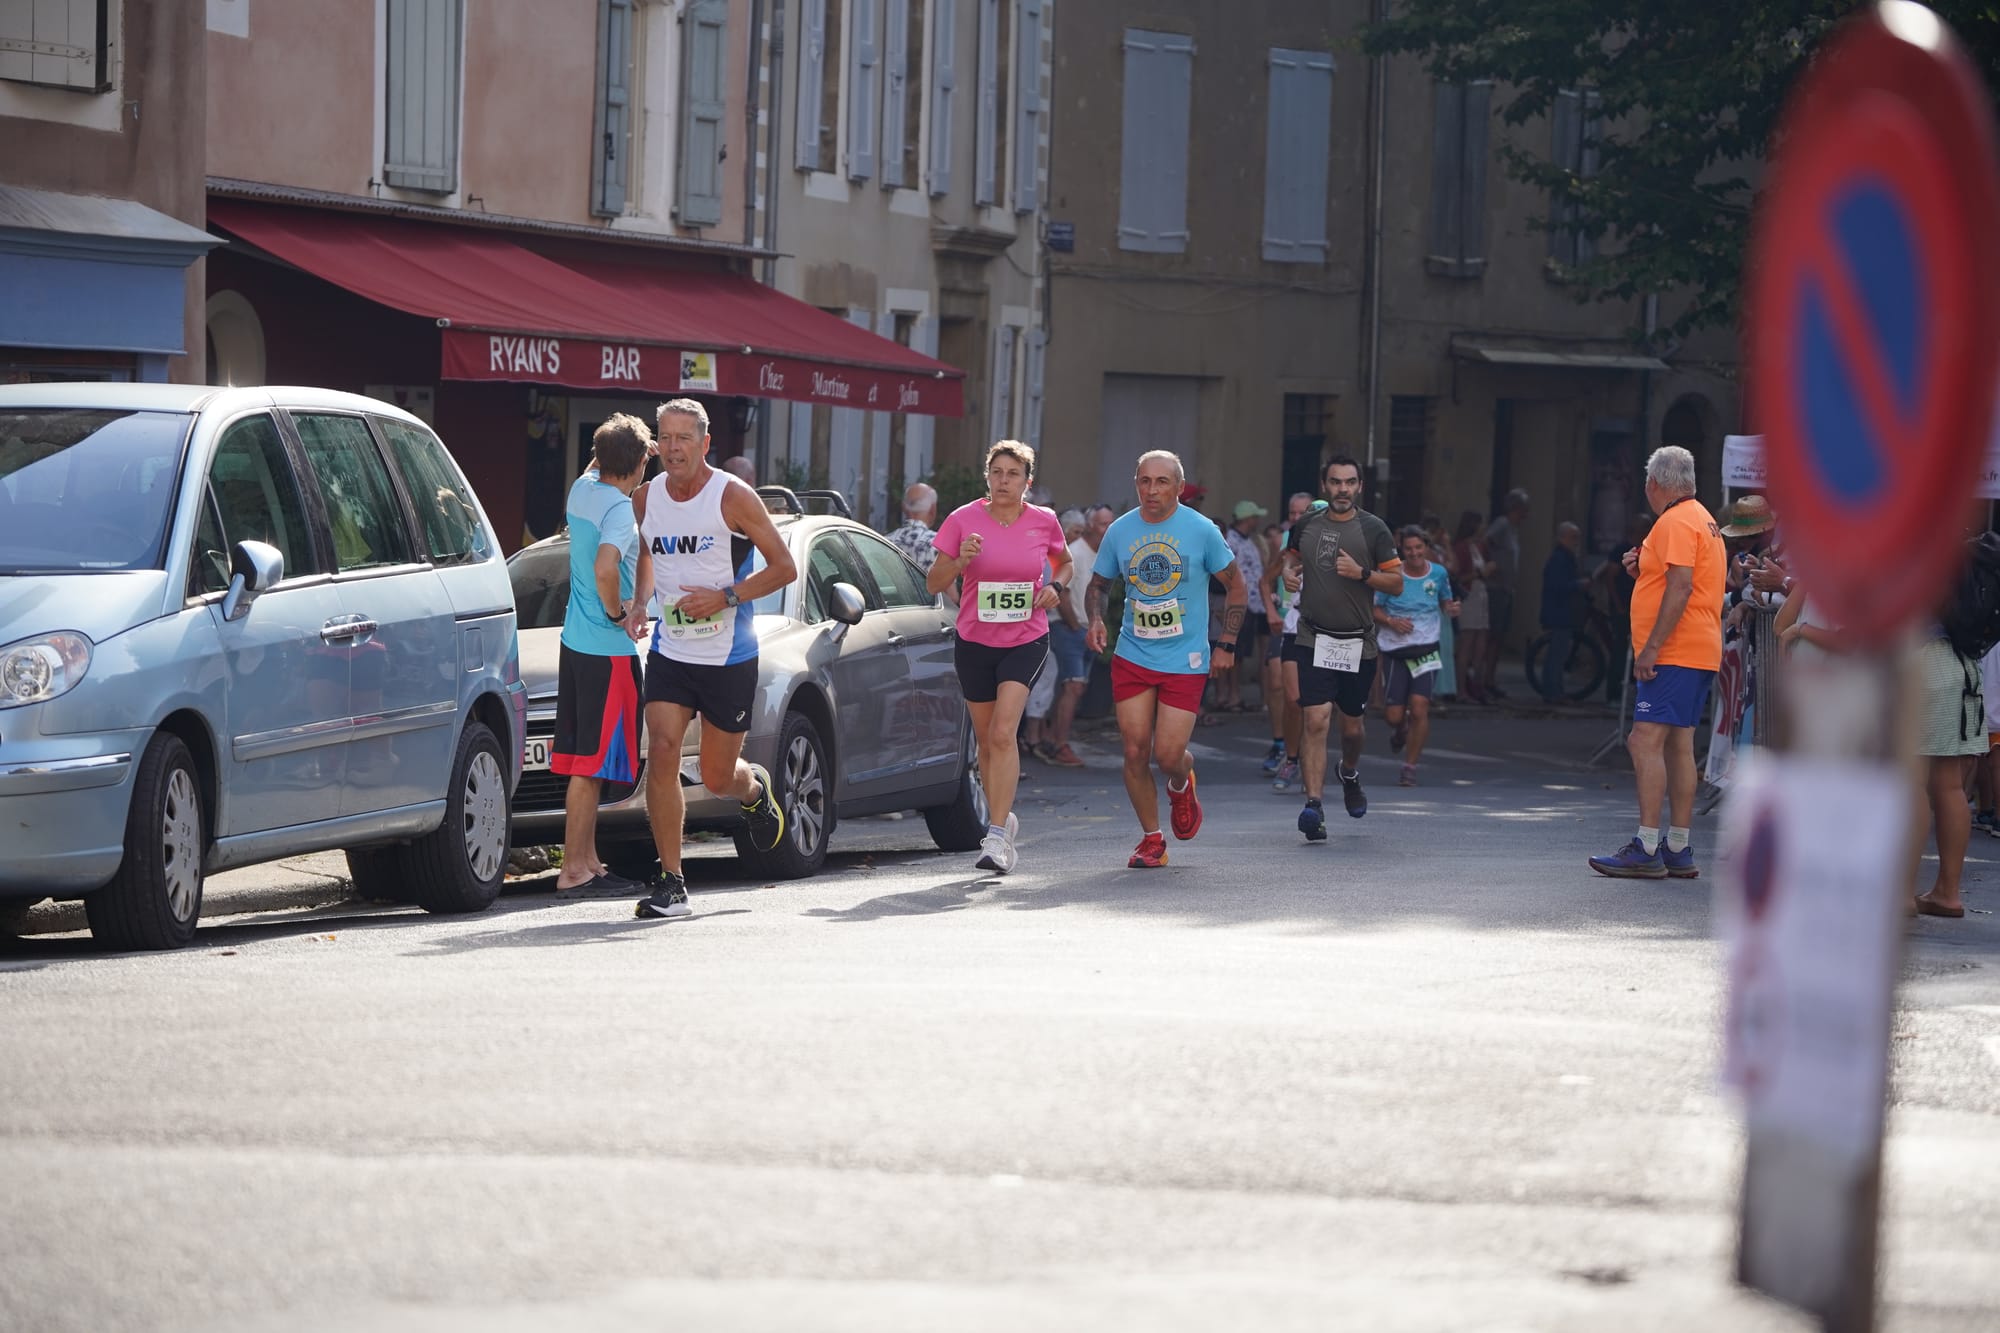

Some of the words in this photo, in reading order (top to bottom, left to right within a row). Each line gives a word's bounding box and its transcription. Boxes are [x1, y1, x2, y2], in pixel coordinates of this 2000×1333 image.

[489, 336, 560, 375] RYAN'S
[600, 346, 641, 381] BAR
[759, 362, 784, 391] Chez
[811, 372, 850, 399] Martine
[868, 382, 879, 402] et
[897, 380, 919, 410] John
[652, 536, 697, 554] AVW
[986, 593, 1026, 609] 155
[1138, 611, 1173, 627] 109
[1325, 648, 1351, 662] 204
[1322, 660, 1351, 671] TUFF'S
